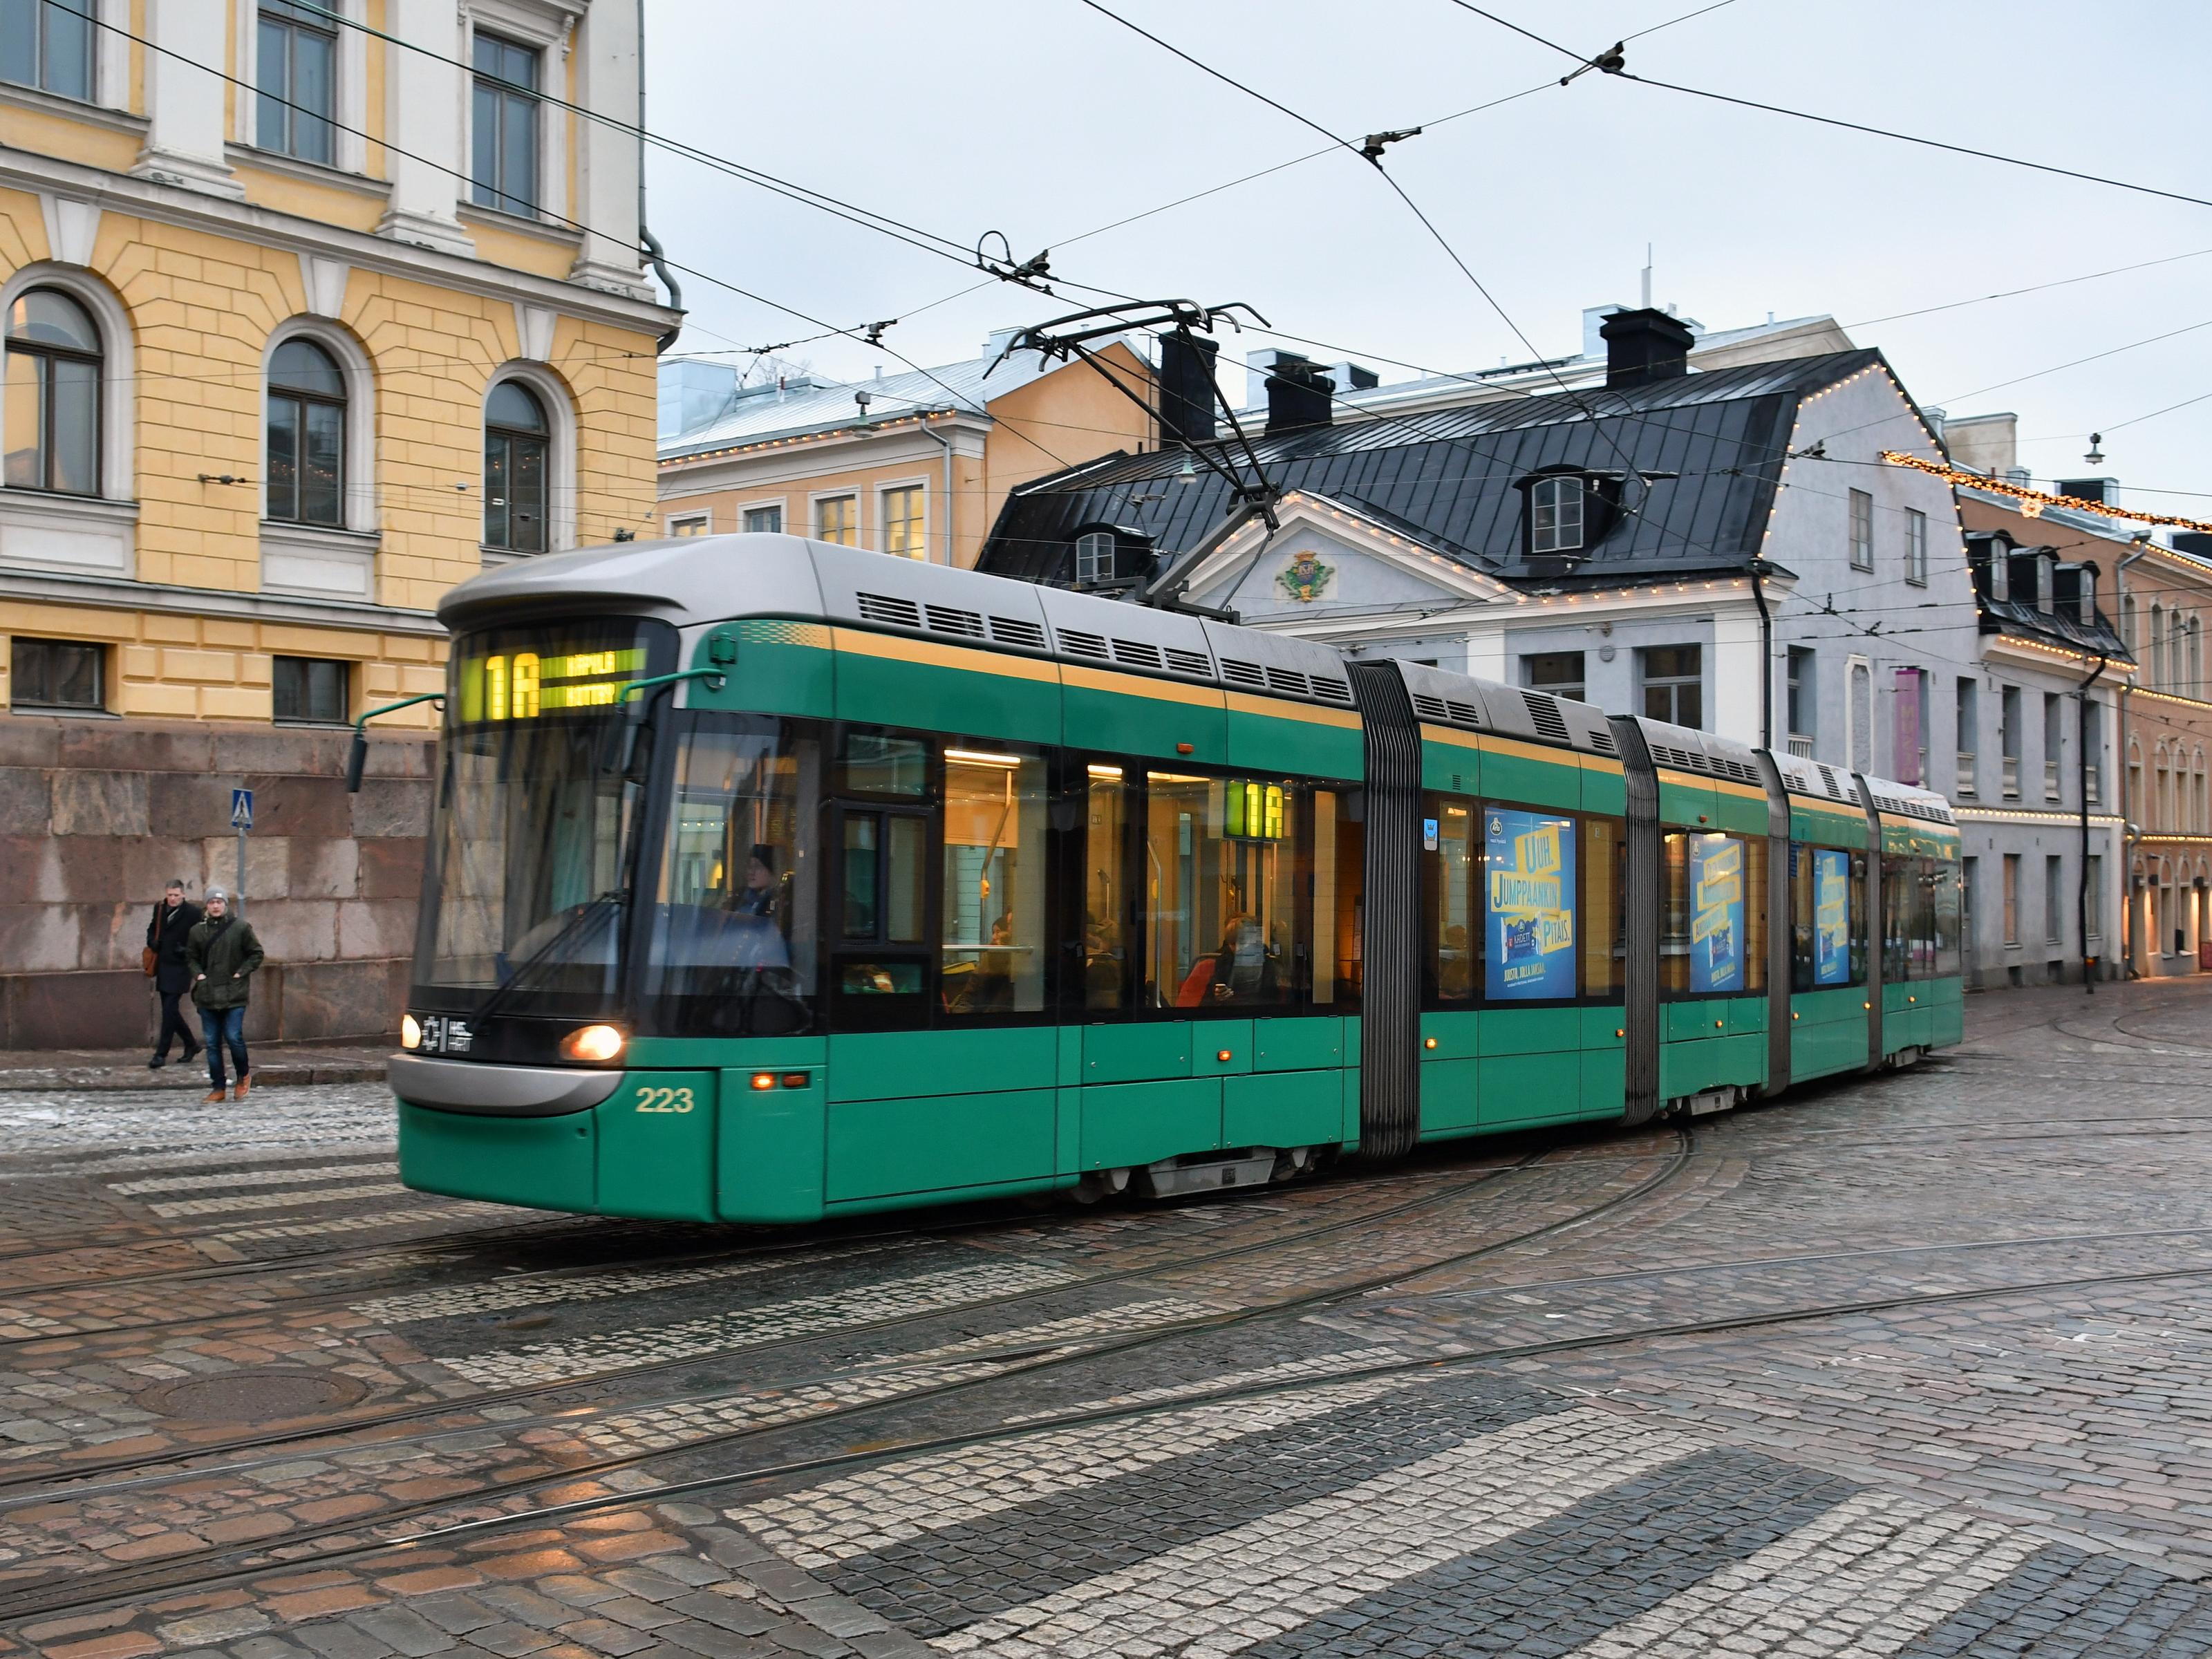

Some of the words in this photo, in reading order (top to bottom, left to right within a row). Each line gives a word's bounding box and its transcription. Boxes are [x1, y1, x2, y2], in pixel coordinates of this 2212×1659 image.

[486, 653, 540, 720] 1A
[1246, 783, 1283, 838] 1A
[1514, 932, 1530, 944] KADETT
[1543, 917, 1570, 947] PITÄIS.
[635, 1087, 695, 1113] 223
